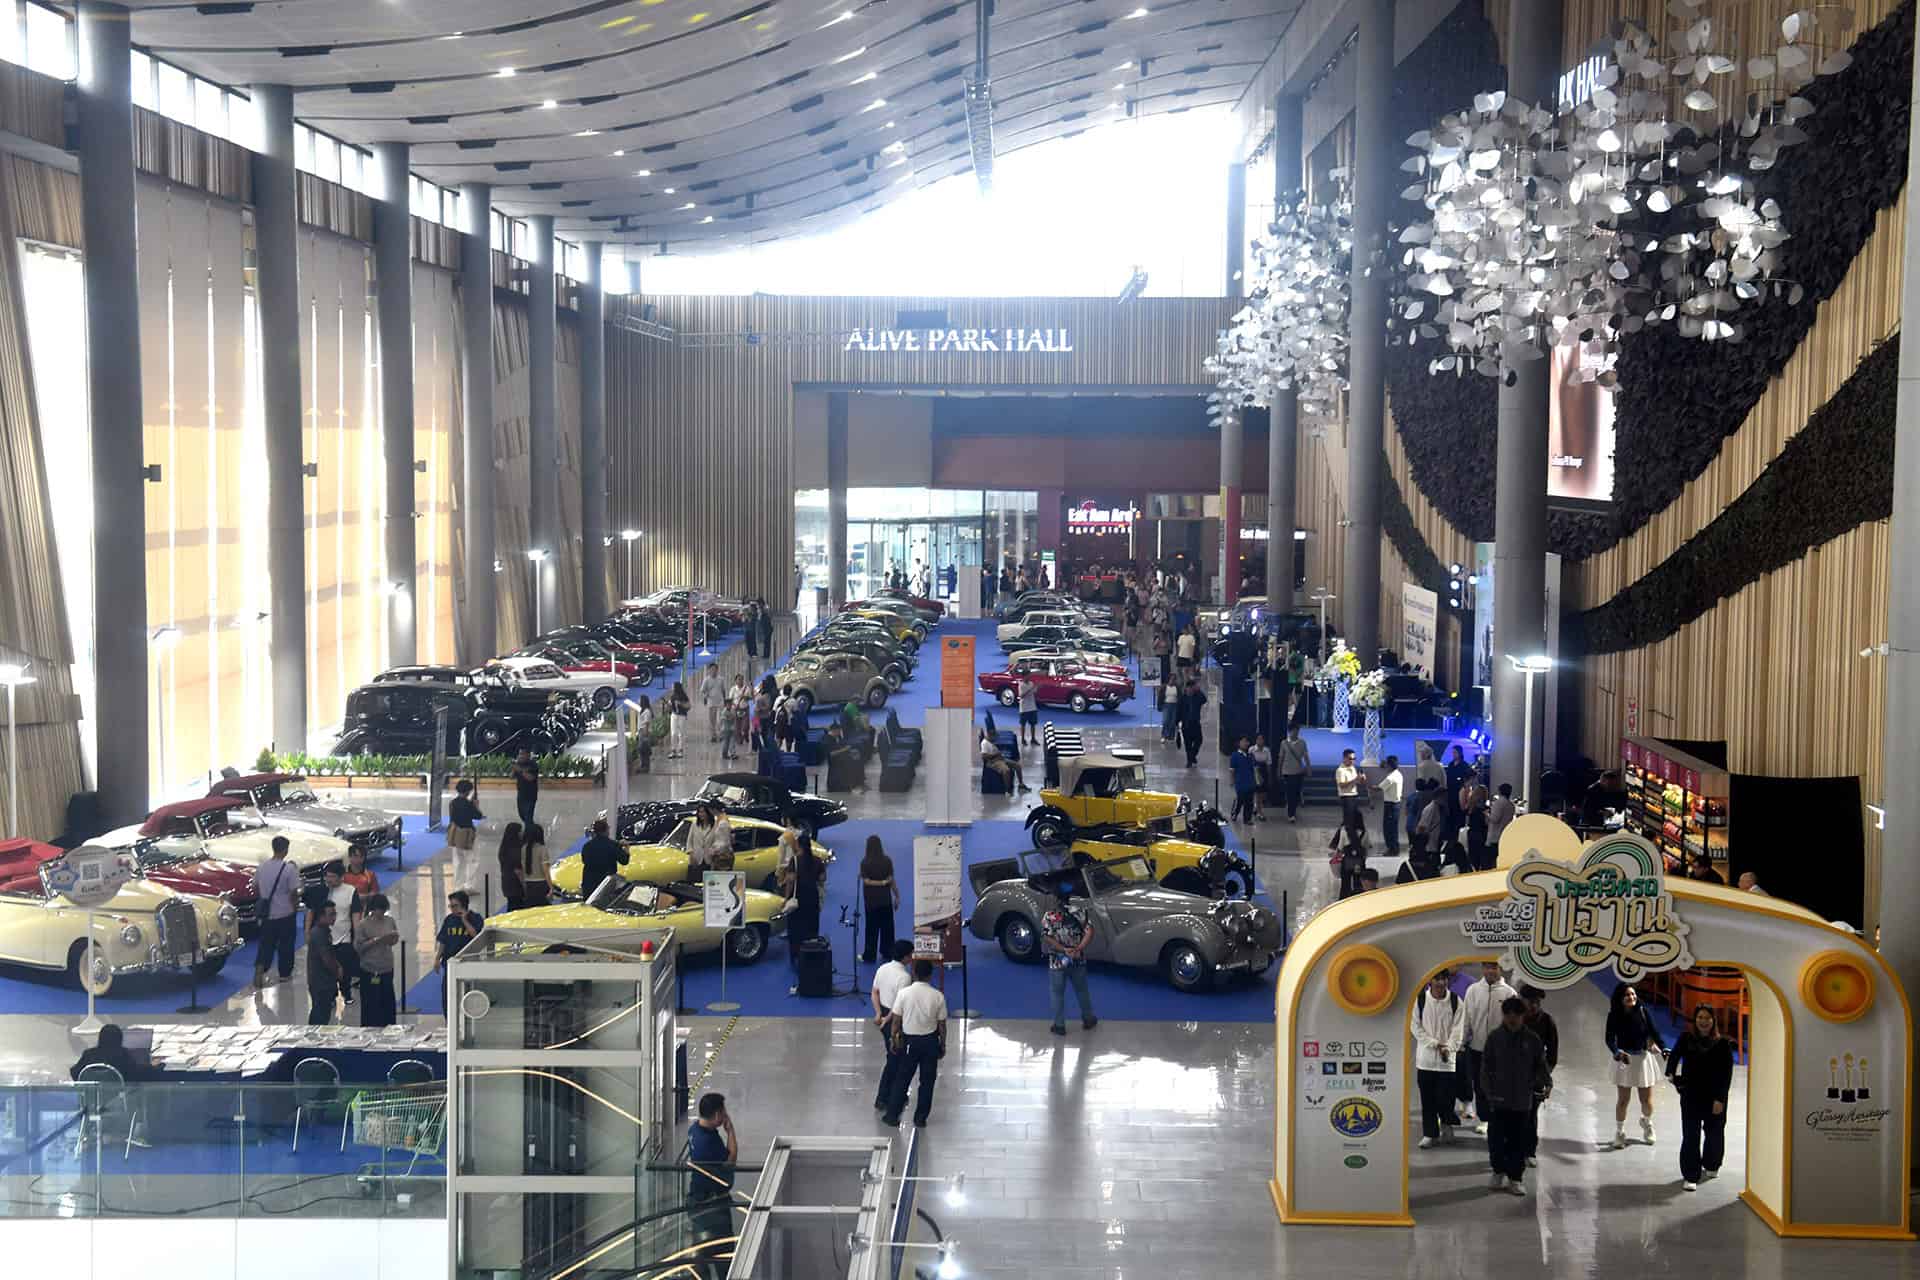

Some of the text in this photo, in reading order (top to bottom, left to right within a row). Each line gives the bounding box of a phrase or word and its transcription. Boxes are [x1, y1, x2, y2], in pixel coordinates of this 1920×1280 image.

[845, 327, 1073, 352] ALIVE PARK HALL
[1503, 902, 1535, 921] 48
[1464, 920, 1509, 932] Vintage
